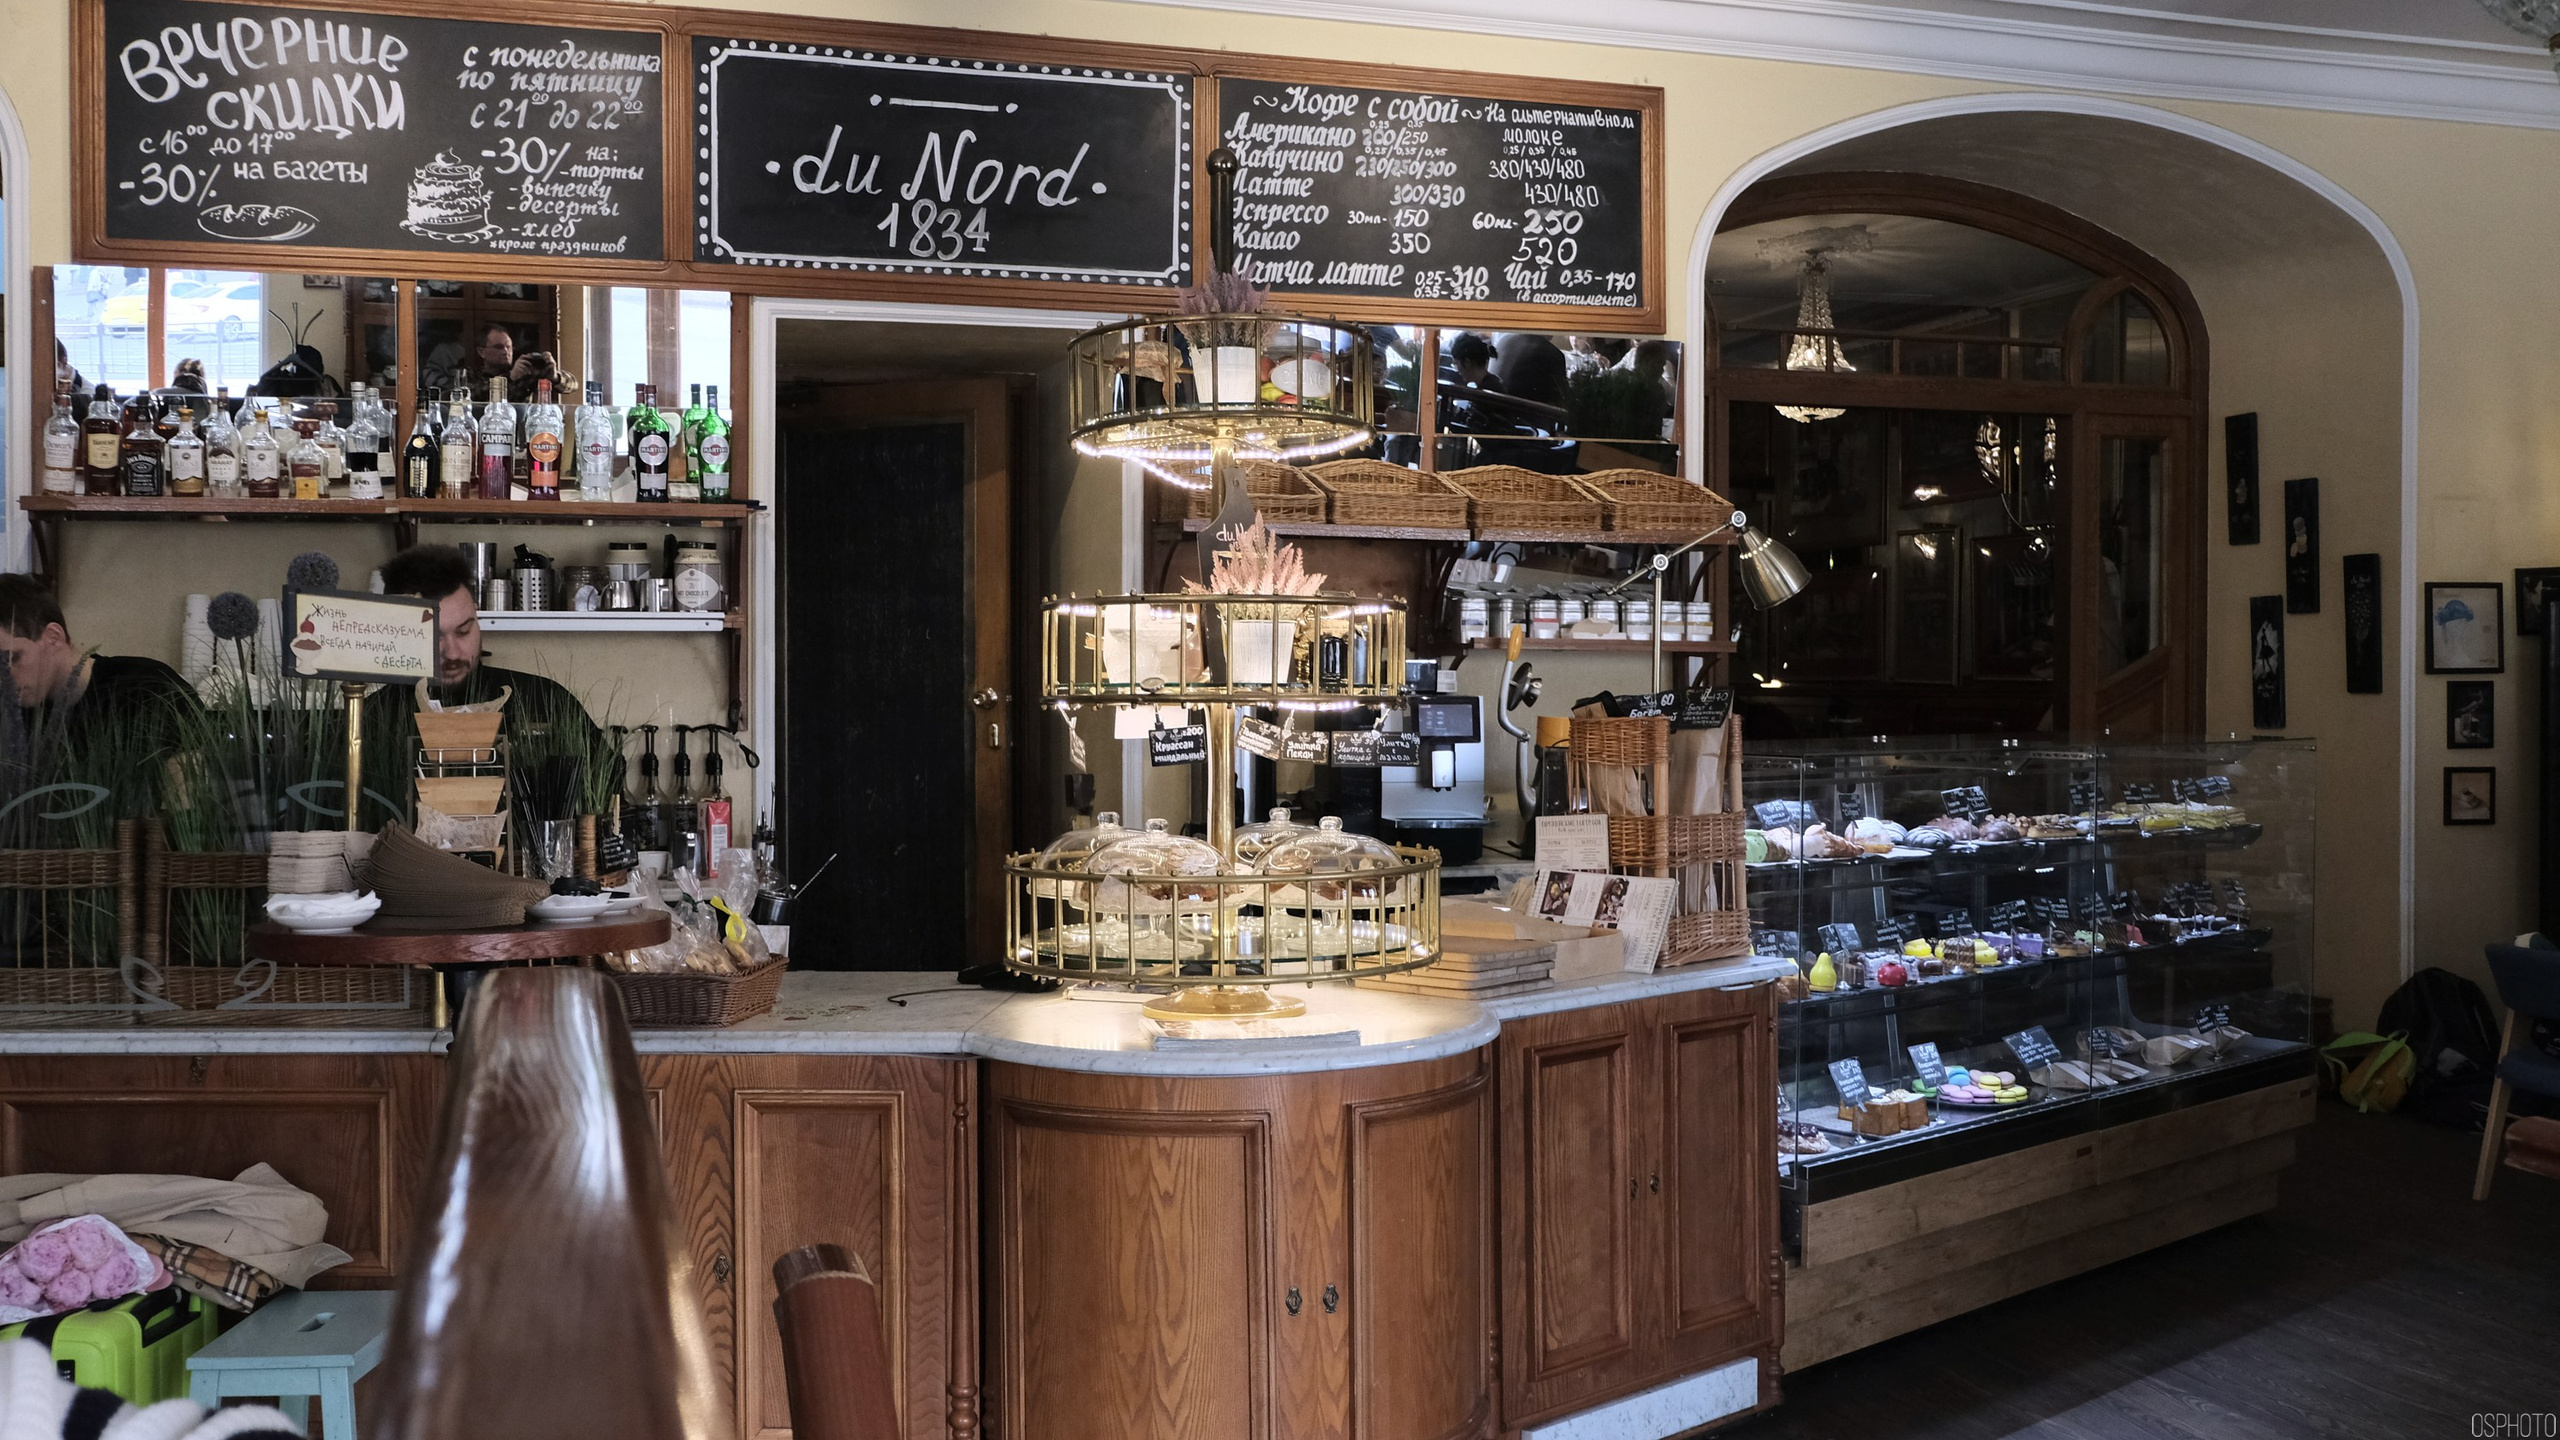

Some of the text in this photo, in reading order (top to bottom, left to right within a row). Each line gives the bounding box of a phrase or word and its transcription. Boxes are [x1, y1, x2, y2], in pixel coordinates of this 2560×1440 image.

[489, 39, 661, 73] понедельника
[456, 69, 643, 102] по пятницу
[207, 72, 405, 139] СКИДКИ
[549, 100, 580, 129] до
[1281, 86, 1359, 122] Кофе
[1387, 95, 1460, 123] собой
[1484, 102, 1634, 129] На альтернативном
[1224, 112, 1356, 150] Американо
[1502, 128, 1563, 146] молоке
[209, 137, 242, 156] до
[1227, 140, 1344, 177] Капучино
[233, 161, 265, 180] на
[792, 124, 1091, 207] du Nord
[1488, 158, 1586, 180] 380/430/480
[1233, 168, 1314, 198] Латте
[1524, 182, 1600, 208] 430/480
[877, 199, 990, 261] 1834
[1393, 208, 1430, 228] 150
[1522, 208, 1584, 236] 250
[541, 235, 627, 255] праздников
[1233, 222, 1431, 255] Какао 350
[1511, 237, 1578, 266] 520
[1317, 261, 1405, 287] латте
[1504, 262, 1549, 290] Чай
[355, 641, 397, 654] НАЧИНАЙ
[1660, 693, 1675, 707] 60
[1155, 741, 1194, 752] Круассан
[1287, 749, 1313, 759] Пекан
